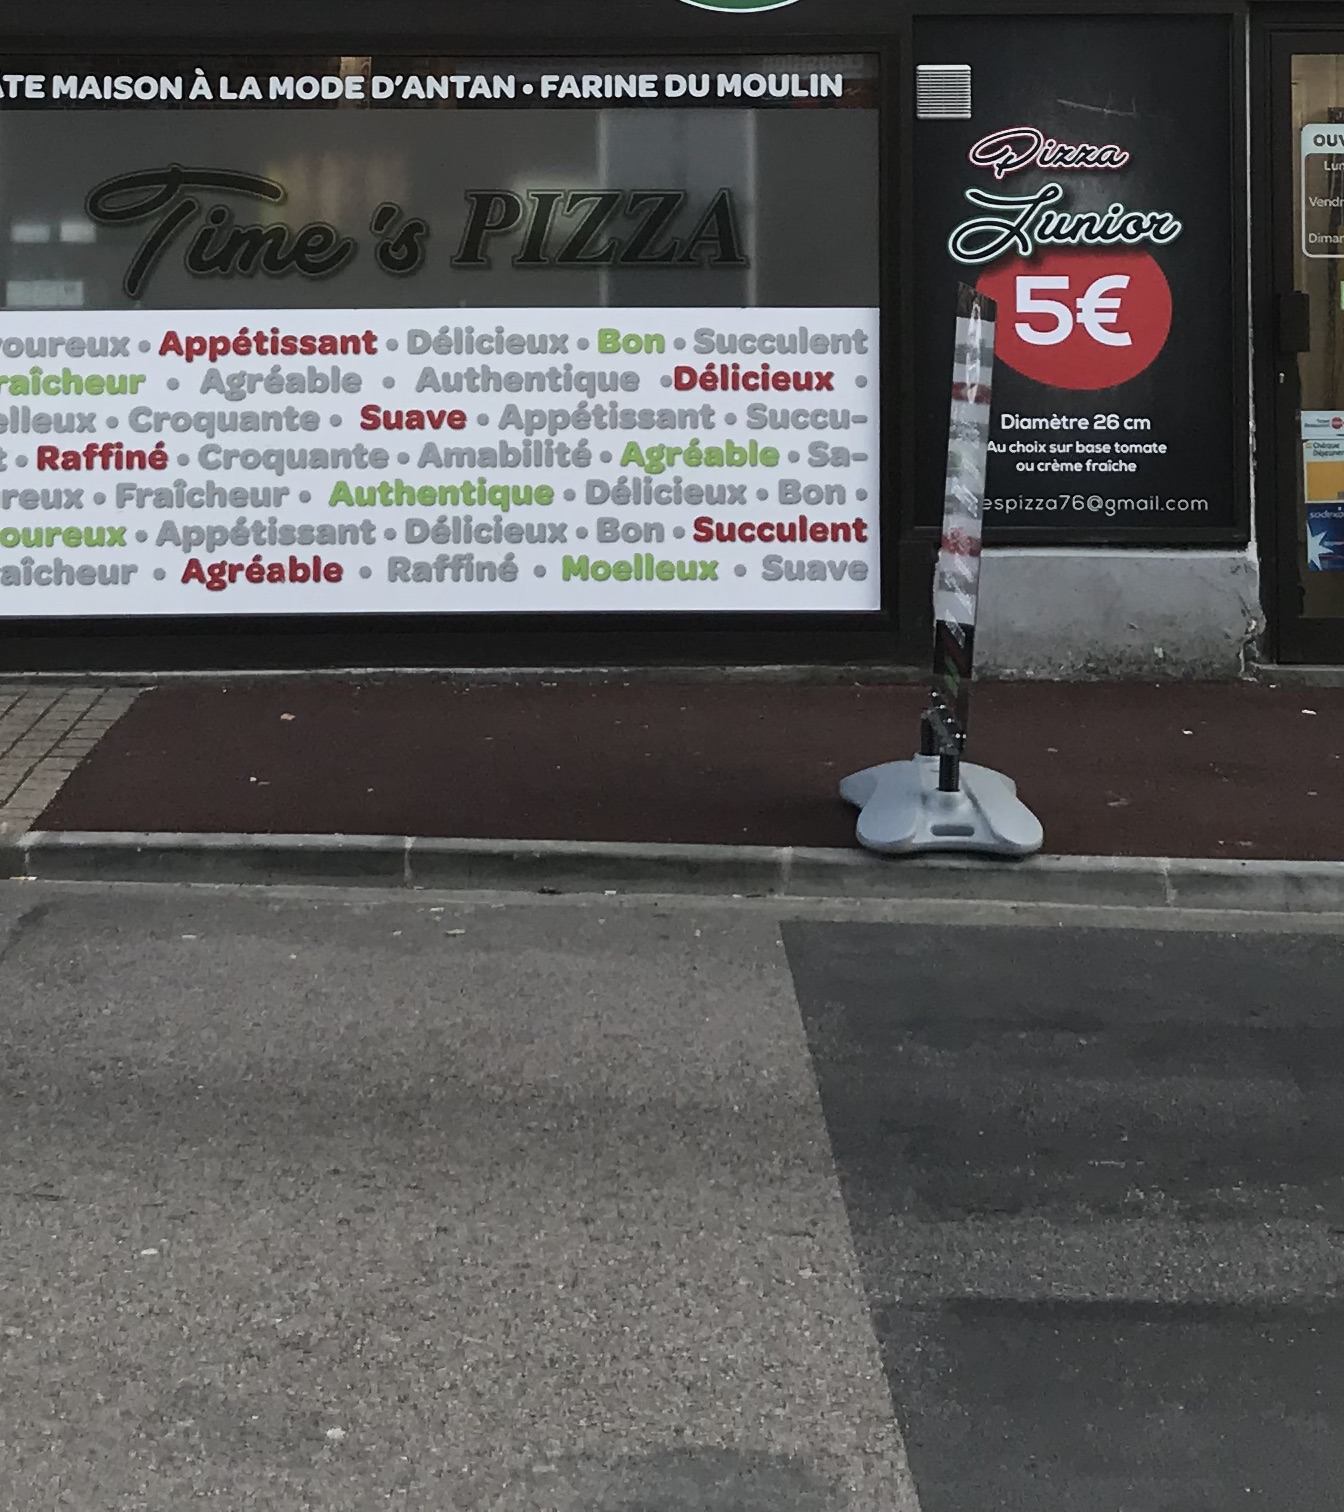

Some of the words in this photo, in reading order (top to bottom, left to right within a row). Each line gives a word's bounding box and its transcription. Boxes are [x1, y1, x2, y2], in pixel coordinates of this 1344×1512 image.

[53, 75, 183, 100] MAISON
[189, 68, 214, 99] À
[220, 75, 259, 100] LA
[269, 75, 364, 100] MODE
[371, 74, 515, 99] D'ANTAN
[541, 74, 658, 99] FARINE
[666, 74, 710, 98] DU
[717, 73, 843, 98] MOULIN
[969, 127, 1130, 178] Pizza
[86, 163, 429, 296] Time's
[450, 187, 751, 269] PIZZA
[948, 183, 1182, 264] Junior
[1014, 275, 1132, 347] 5€
[159, 327, 378, 362] Appétissant
[407, 326, 568, 355] Délicieux
[597, 328, 665, 354] Bon
[693, 326, 868, 355] Succulent
[200, 365, 362, 401] Agréable
[415, 365, 640, 398] Authentique
[673, 363, 834, 391] Délicieux
[129, 405, 320, 438] Croquante
[361, 404, 467, 430] Suave
[498, 401, 716, 436] Appétissant
[746, 403, 868, 430] Succu-
[1001, 414, 1089, 430] Diamètre
[1093, 414, 1120, 430] 26
[1123, 416, 1151, 430] cm
[37, 441, 168, 470] Raffiné
[198, 443, 389, 475] Croquante
[417, 438, 591, 469] Amabilité
[620, 438, 779, 474] Agréable
[808, 441, 868, 468] Sa-
[987, 441, 1006, 453] Au
[1009, 441, 1046, 454] choix
[1049, 443, 1073, 454] sur
[1075, 441, 1111, 454] base
[1114, 442, 1167, 454] tomate
[1016, 462, 1034, 472] ou
[1037, 459, 1083, 472] crème
[1086, 459, 1137, 472] fraîche
[116, 479, 290, 508] Fraîcheur
[328, 476, 554, 512] Authentique
[586, 476, 747, 505] Délicieux
[778, 479, 846, 505] Bon
[156, 517, 375, 553] Appétissant
[405, 515, 568, 544] Délicieux
[597, 517, 665, 543] Bon
[693, 515, 868, 543] Succulent
[182, 555, 344, 591] Agréable
[388, 553, 518, 583] Raffiné
[562, 553, 718, 582] Moelleux
[762, 555, 868, 582] Suave
